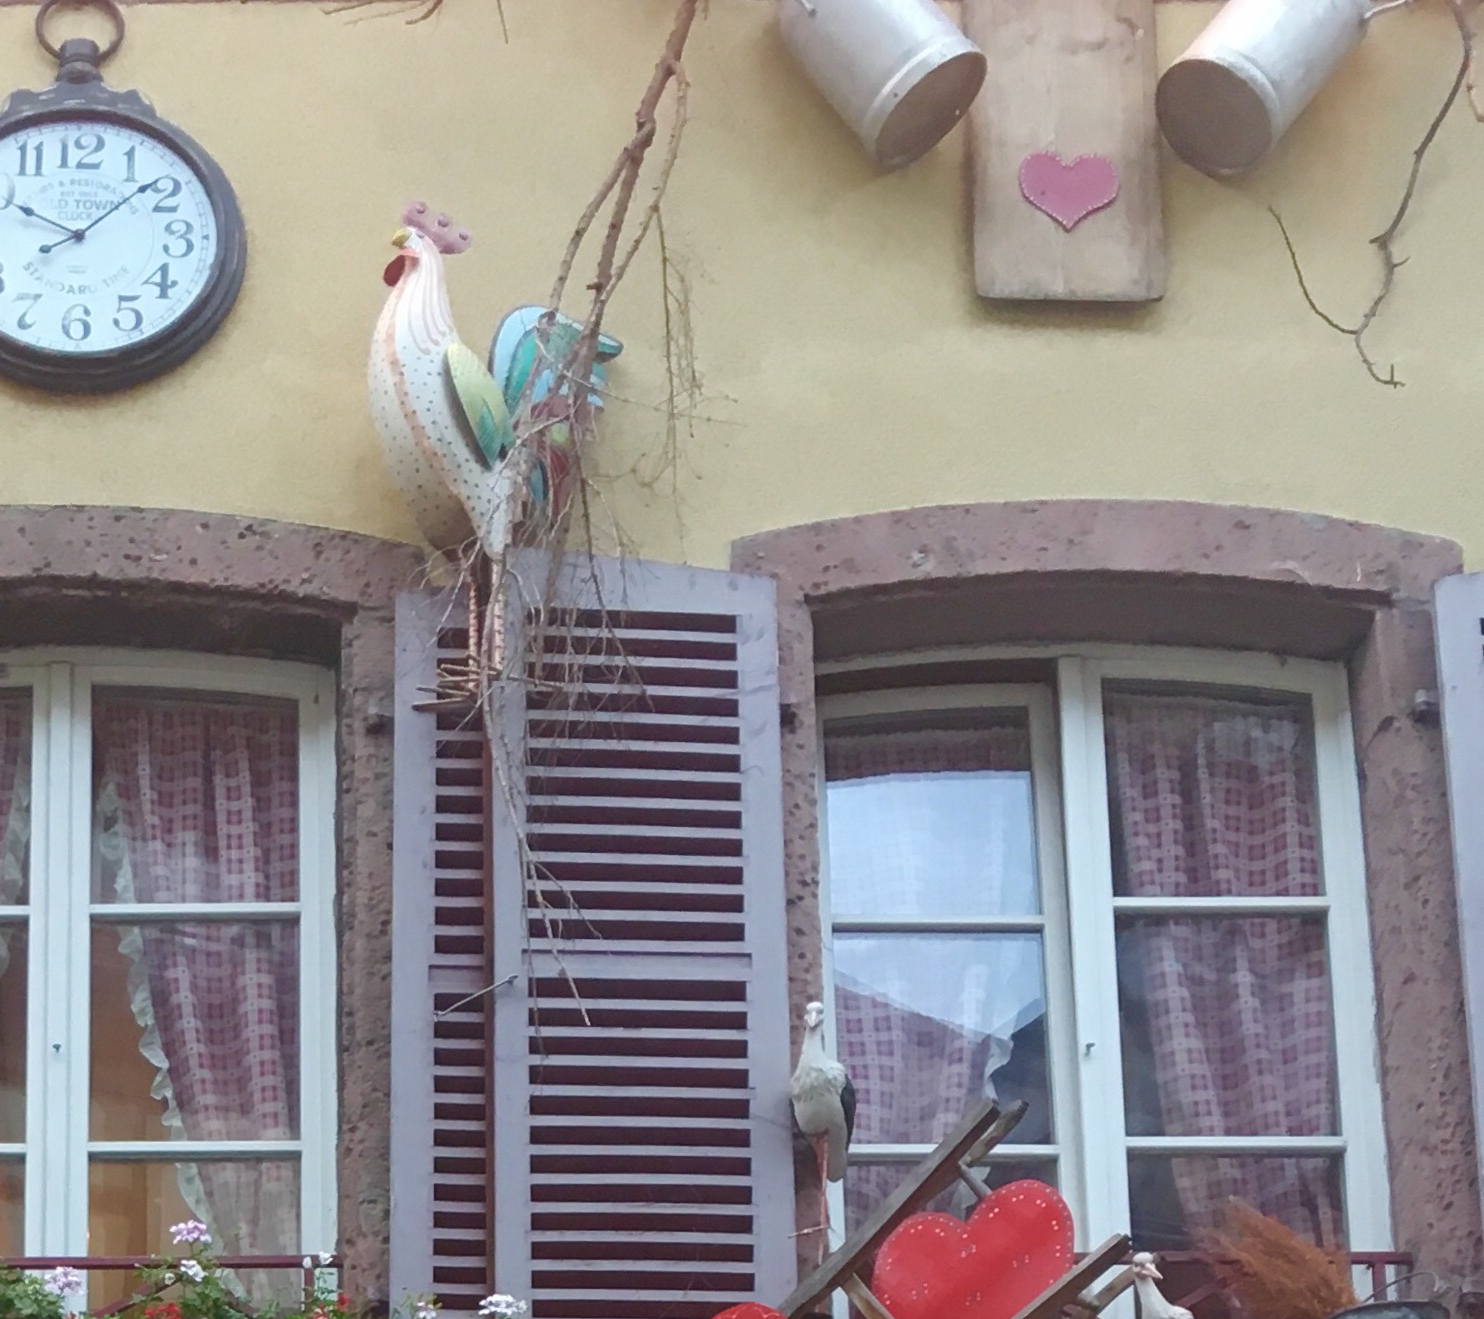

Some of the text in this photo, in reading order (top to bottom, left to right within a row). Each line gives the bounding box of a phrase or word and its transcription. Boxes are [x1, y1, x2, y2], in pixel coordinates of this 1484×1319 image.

[16, 139, 45, 177] 11
[57, 133, 106, 170] 12
[122, 144, 139, 183] 1
[74, 199, 121, 212] TOWN
[150, 174, 183, 214] 2
[162, 218, 195, 259] 3
[141, 262, 179, 300] 4
[11, 292, 43, 330] 7
[61, 303, 92, 341] 6
[112, 294, 144, 332] 5
